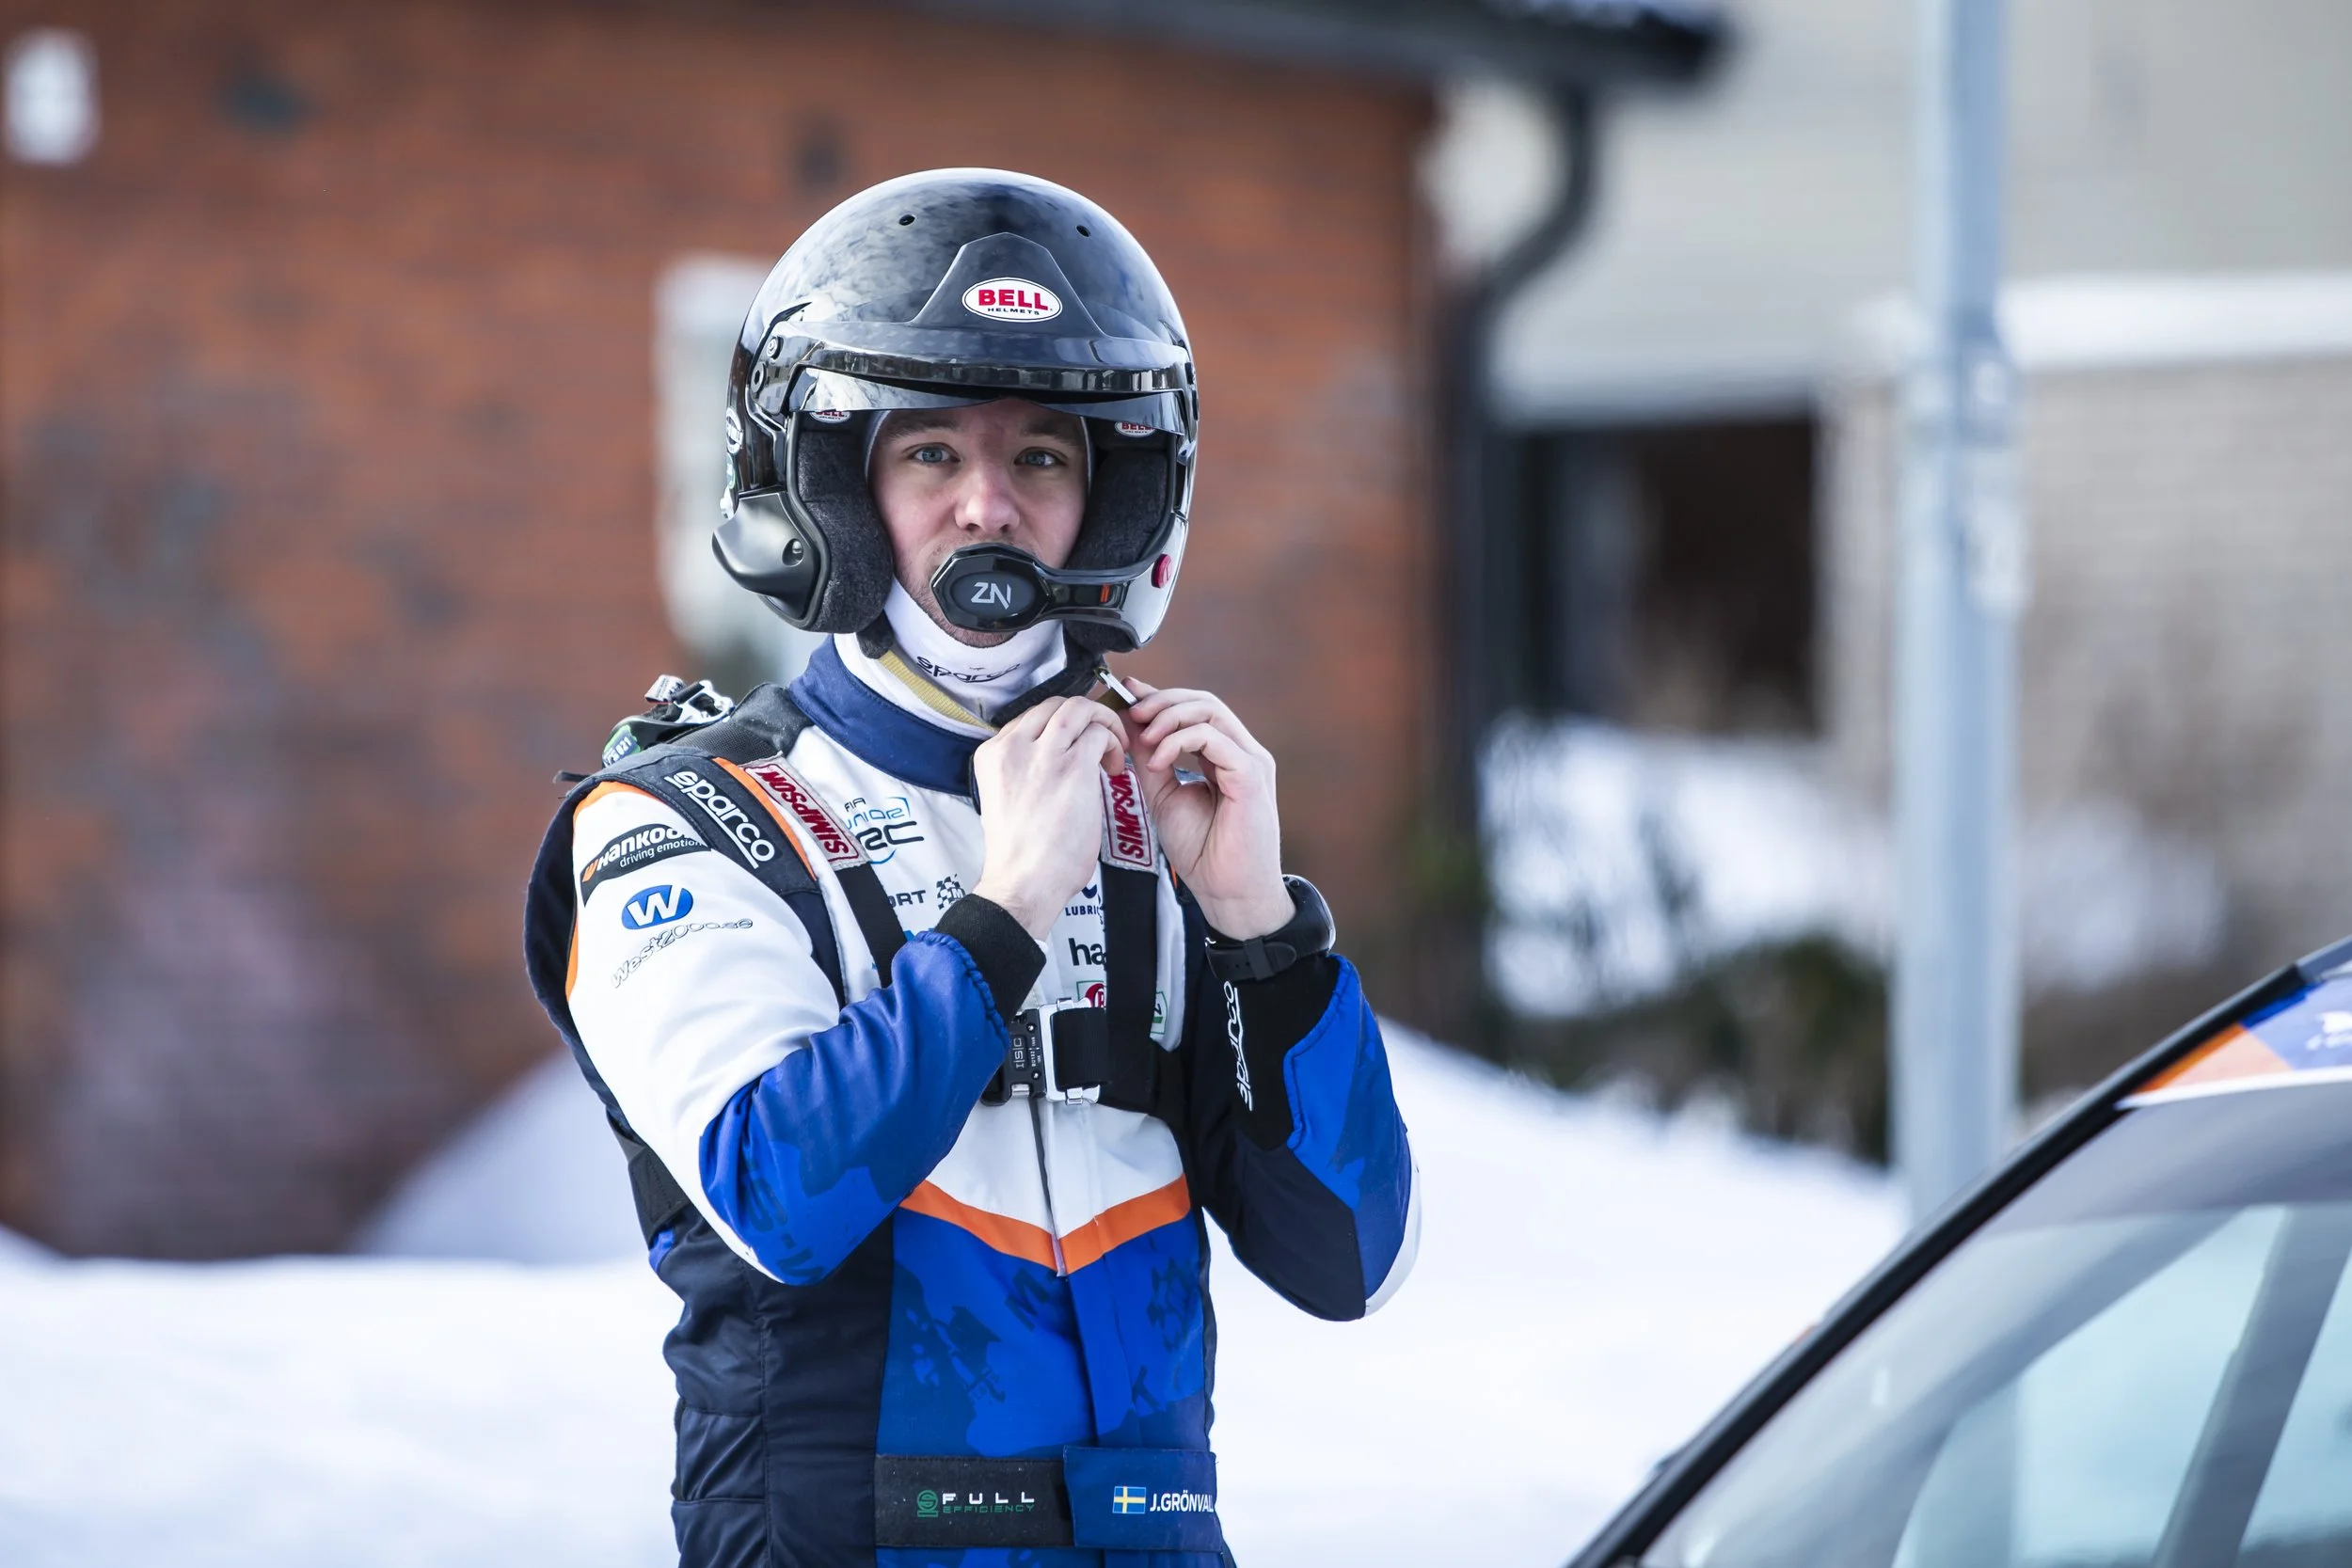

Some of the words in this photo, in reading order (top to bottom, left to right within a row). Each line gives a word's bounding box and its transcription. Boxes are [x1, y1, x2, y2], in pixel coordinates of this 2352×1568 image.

[978, 289, 1049, 311] BELL
[987, 308, 1041, 316] HELMETS
[971, 581, 1012, 610] ZN
[755, 769, 850, 856] SIMPSON
[844, 797, 866, 813] FIA
[663, 770, 775, 870] sparco
[619, 847, 656, 868] driving
[942, 1491, 1035, 1505] FULL
[942, 1504, 1035, 1514] EFFICIENCY
